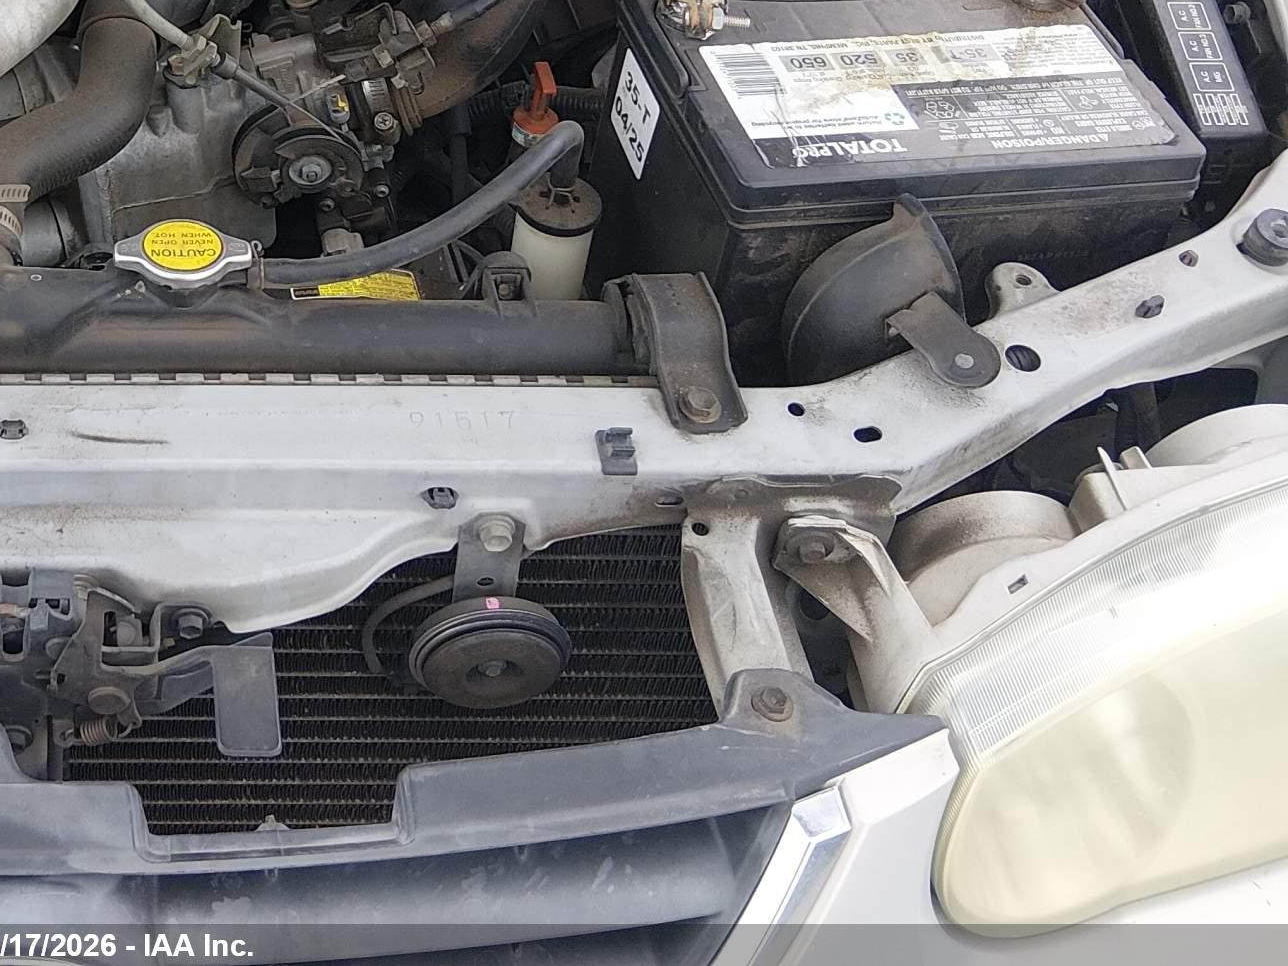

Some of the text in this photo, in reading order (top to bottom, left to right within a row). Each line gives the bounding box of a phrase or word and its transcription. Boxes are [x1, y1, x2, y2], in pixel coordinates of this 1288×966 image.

[840, 54, 877, 66] 520
[895, 52, 919, 63] 35
[948, 48, 987, 60] 35-T
[790, 57, 827, 69] 650
[624, 71, 651, 124] 35-T
[615, 96, 644, 163] 04/25
[151, 248, 216, 258] CAUTION
